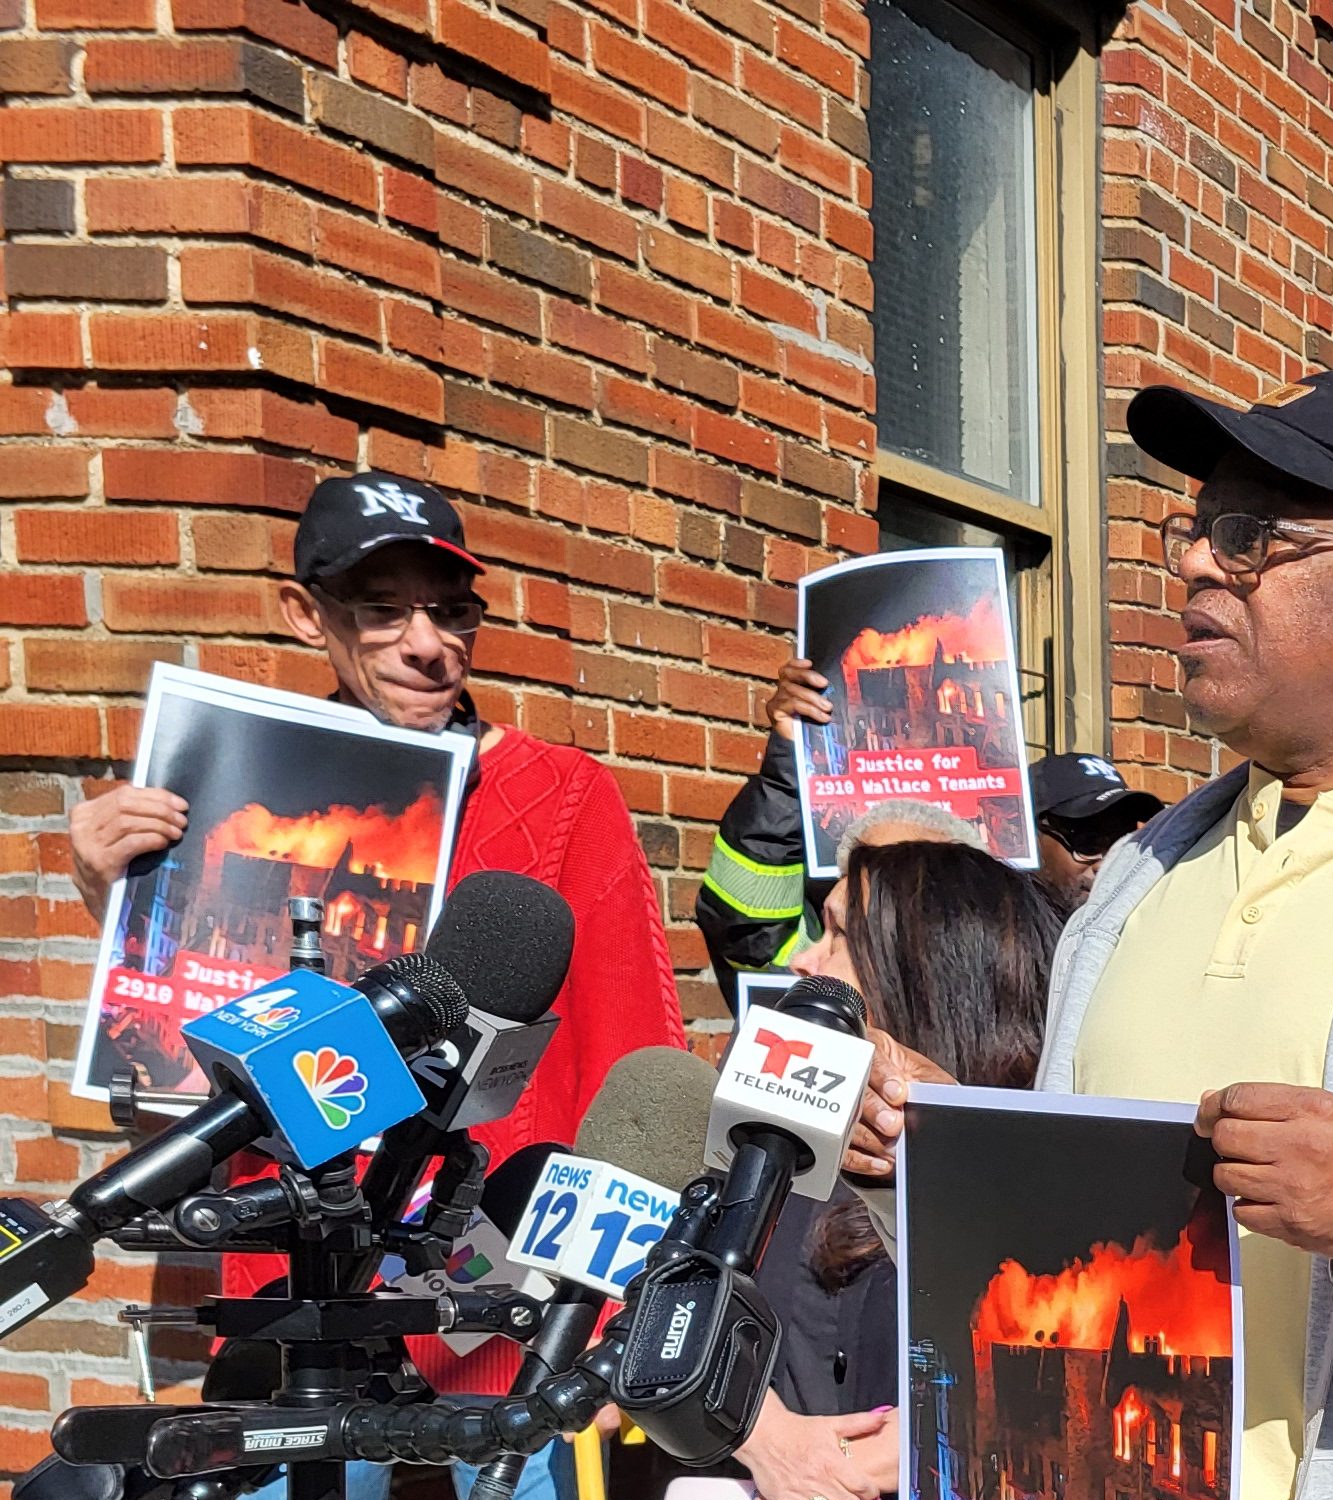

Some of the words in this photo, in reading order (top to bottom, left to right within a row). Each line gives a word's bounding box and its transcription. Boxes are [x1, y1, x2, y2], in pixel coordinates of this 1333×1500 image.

[856, 754, 923, 772] Justice
[932, 754, 960, 770] for
[815, 780, 855, 796] 2910
[863, 776, 931, 794] Wallace
[938, 774, 1006, 792] Tenants
[115, 977, 173, 1004] 2910
[236, 988, 298, 1018] 4
[733, 1070, 841, 1114] TELEMUNDO
[791, 1065, 846, 1094] 47
[545, 1161, 592, 1190] news
[605, 1178, 678, 1222] new
[521, 1190, 578, 1261] 12
